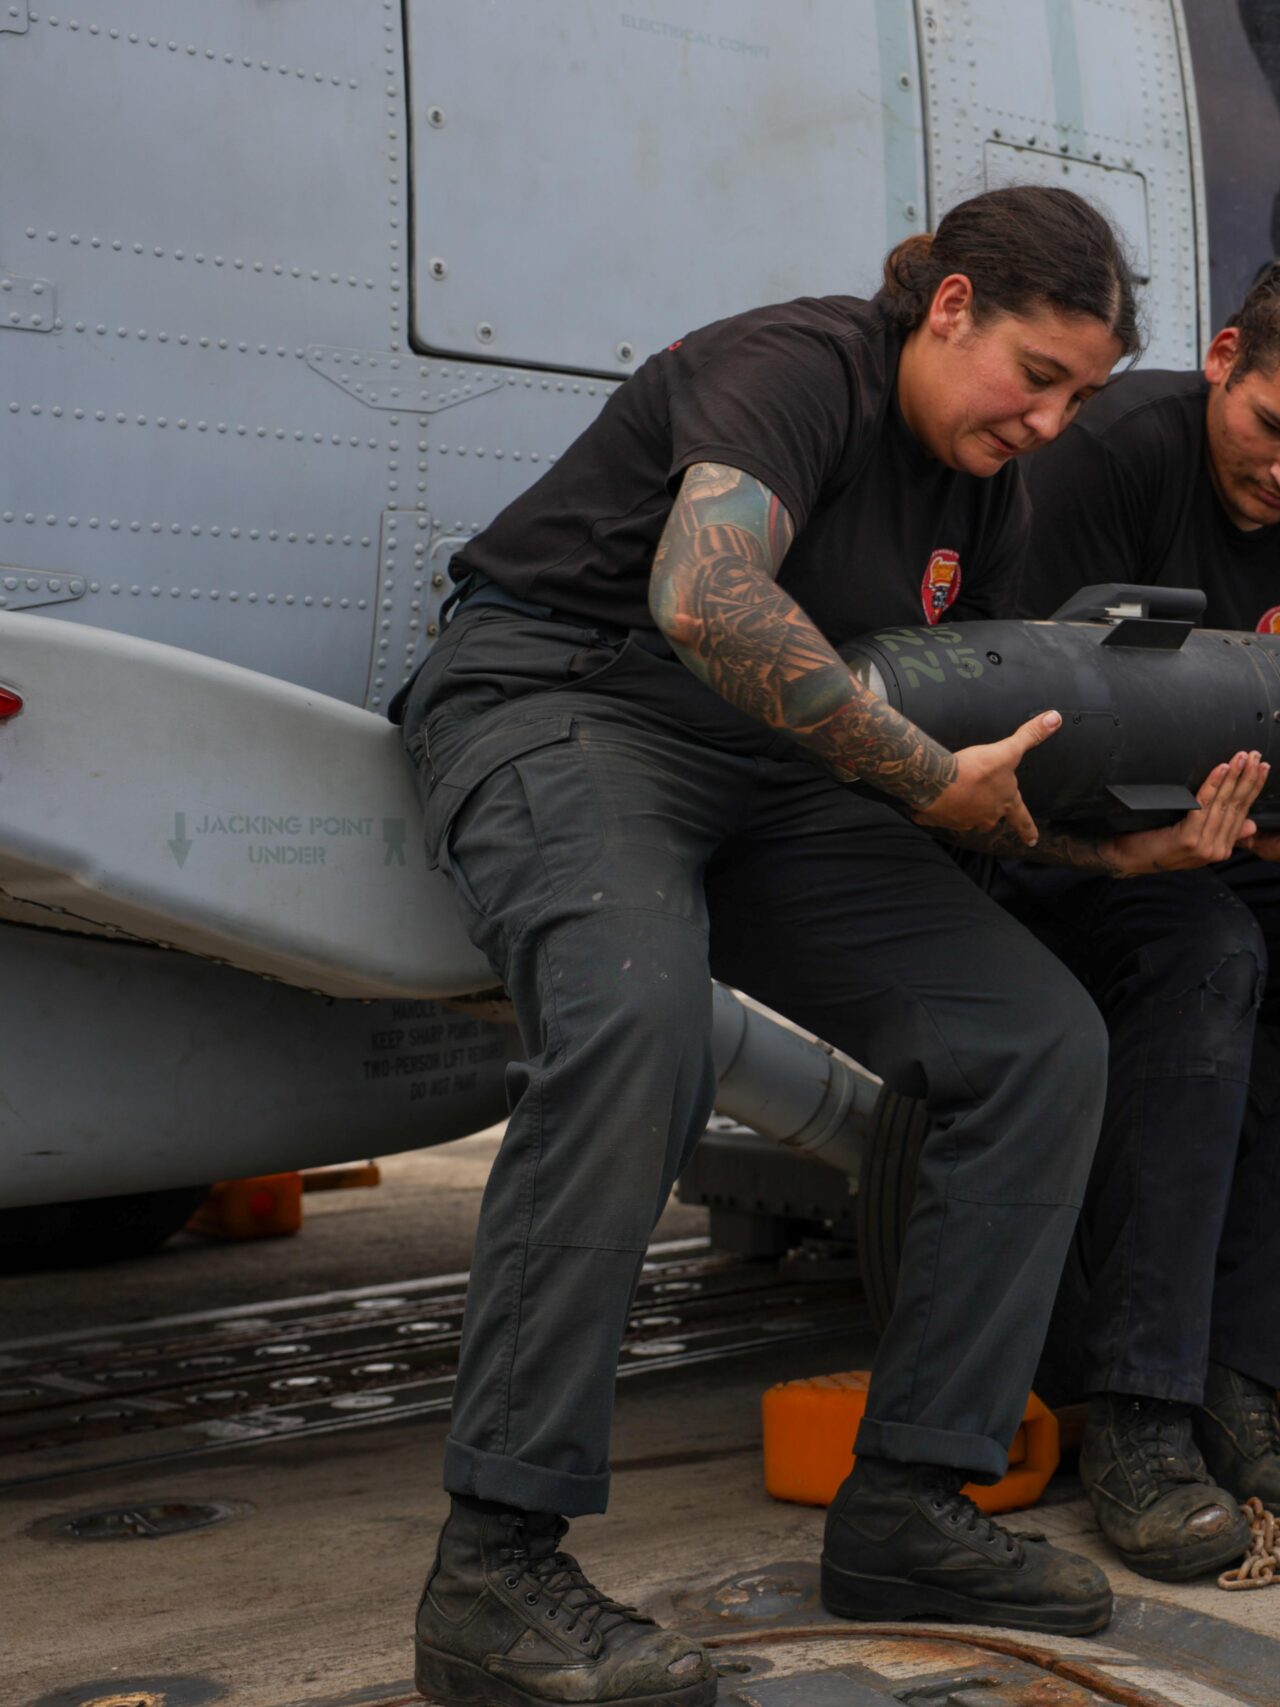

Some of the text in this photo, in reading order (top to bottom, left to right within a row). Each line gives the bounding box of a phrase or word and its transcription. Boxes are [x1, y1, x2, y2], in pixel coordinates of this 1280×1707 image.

[621, 13, 716, 48] ELECTRICAL
[195, 815, 375, 836] JACKING POINT
[248, 846, 326, 865] UNDER
[371, 1030, 404, 1050] KEEP
[409, 1024, 444, 1046] SHARP
[362, 1053, 440, 1080] TWO-PERSON
[444, 1048, 465, 1069] LIFT
[410, 1081, 426, 1101] DO
